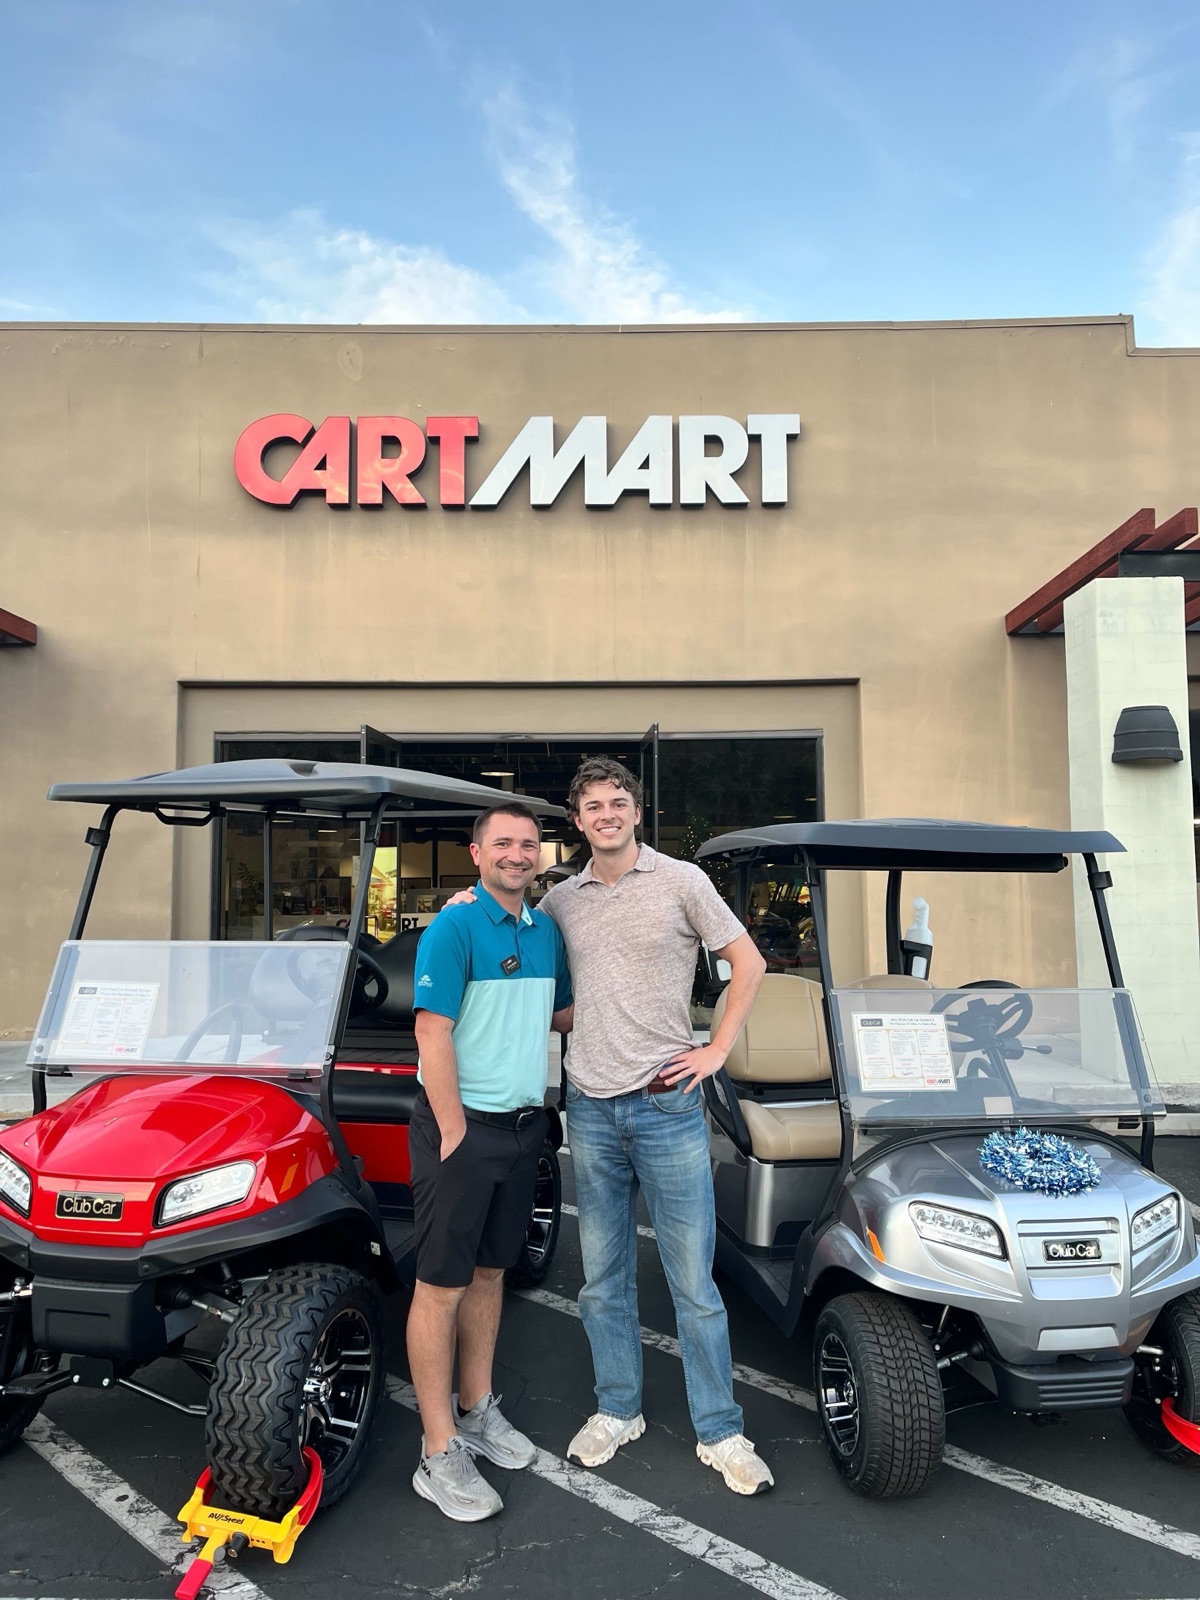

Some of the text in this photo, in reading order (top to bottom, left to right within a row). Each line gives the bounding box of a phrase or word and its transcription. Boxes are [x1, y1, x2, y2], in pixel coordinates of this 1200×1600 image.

[234, 413, 801, 508] CART MART
[63, 1198, 116, 1214] Club Car
[1050, 1244, 1096, 1258] Club Car
